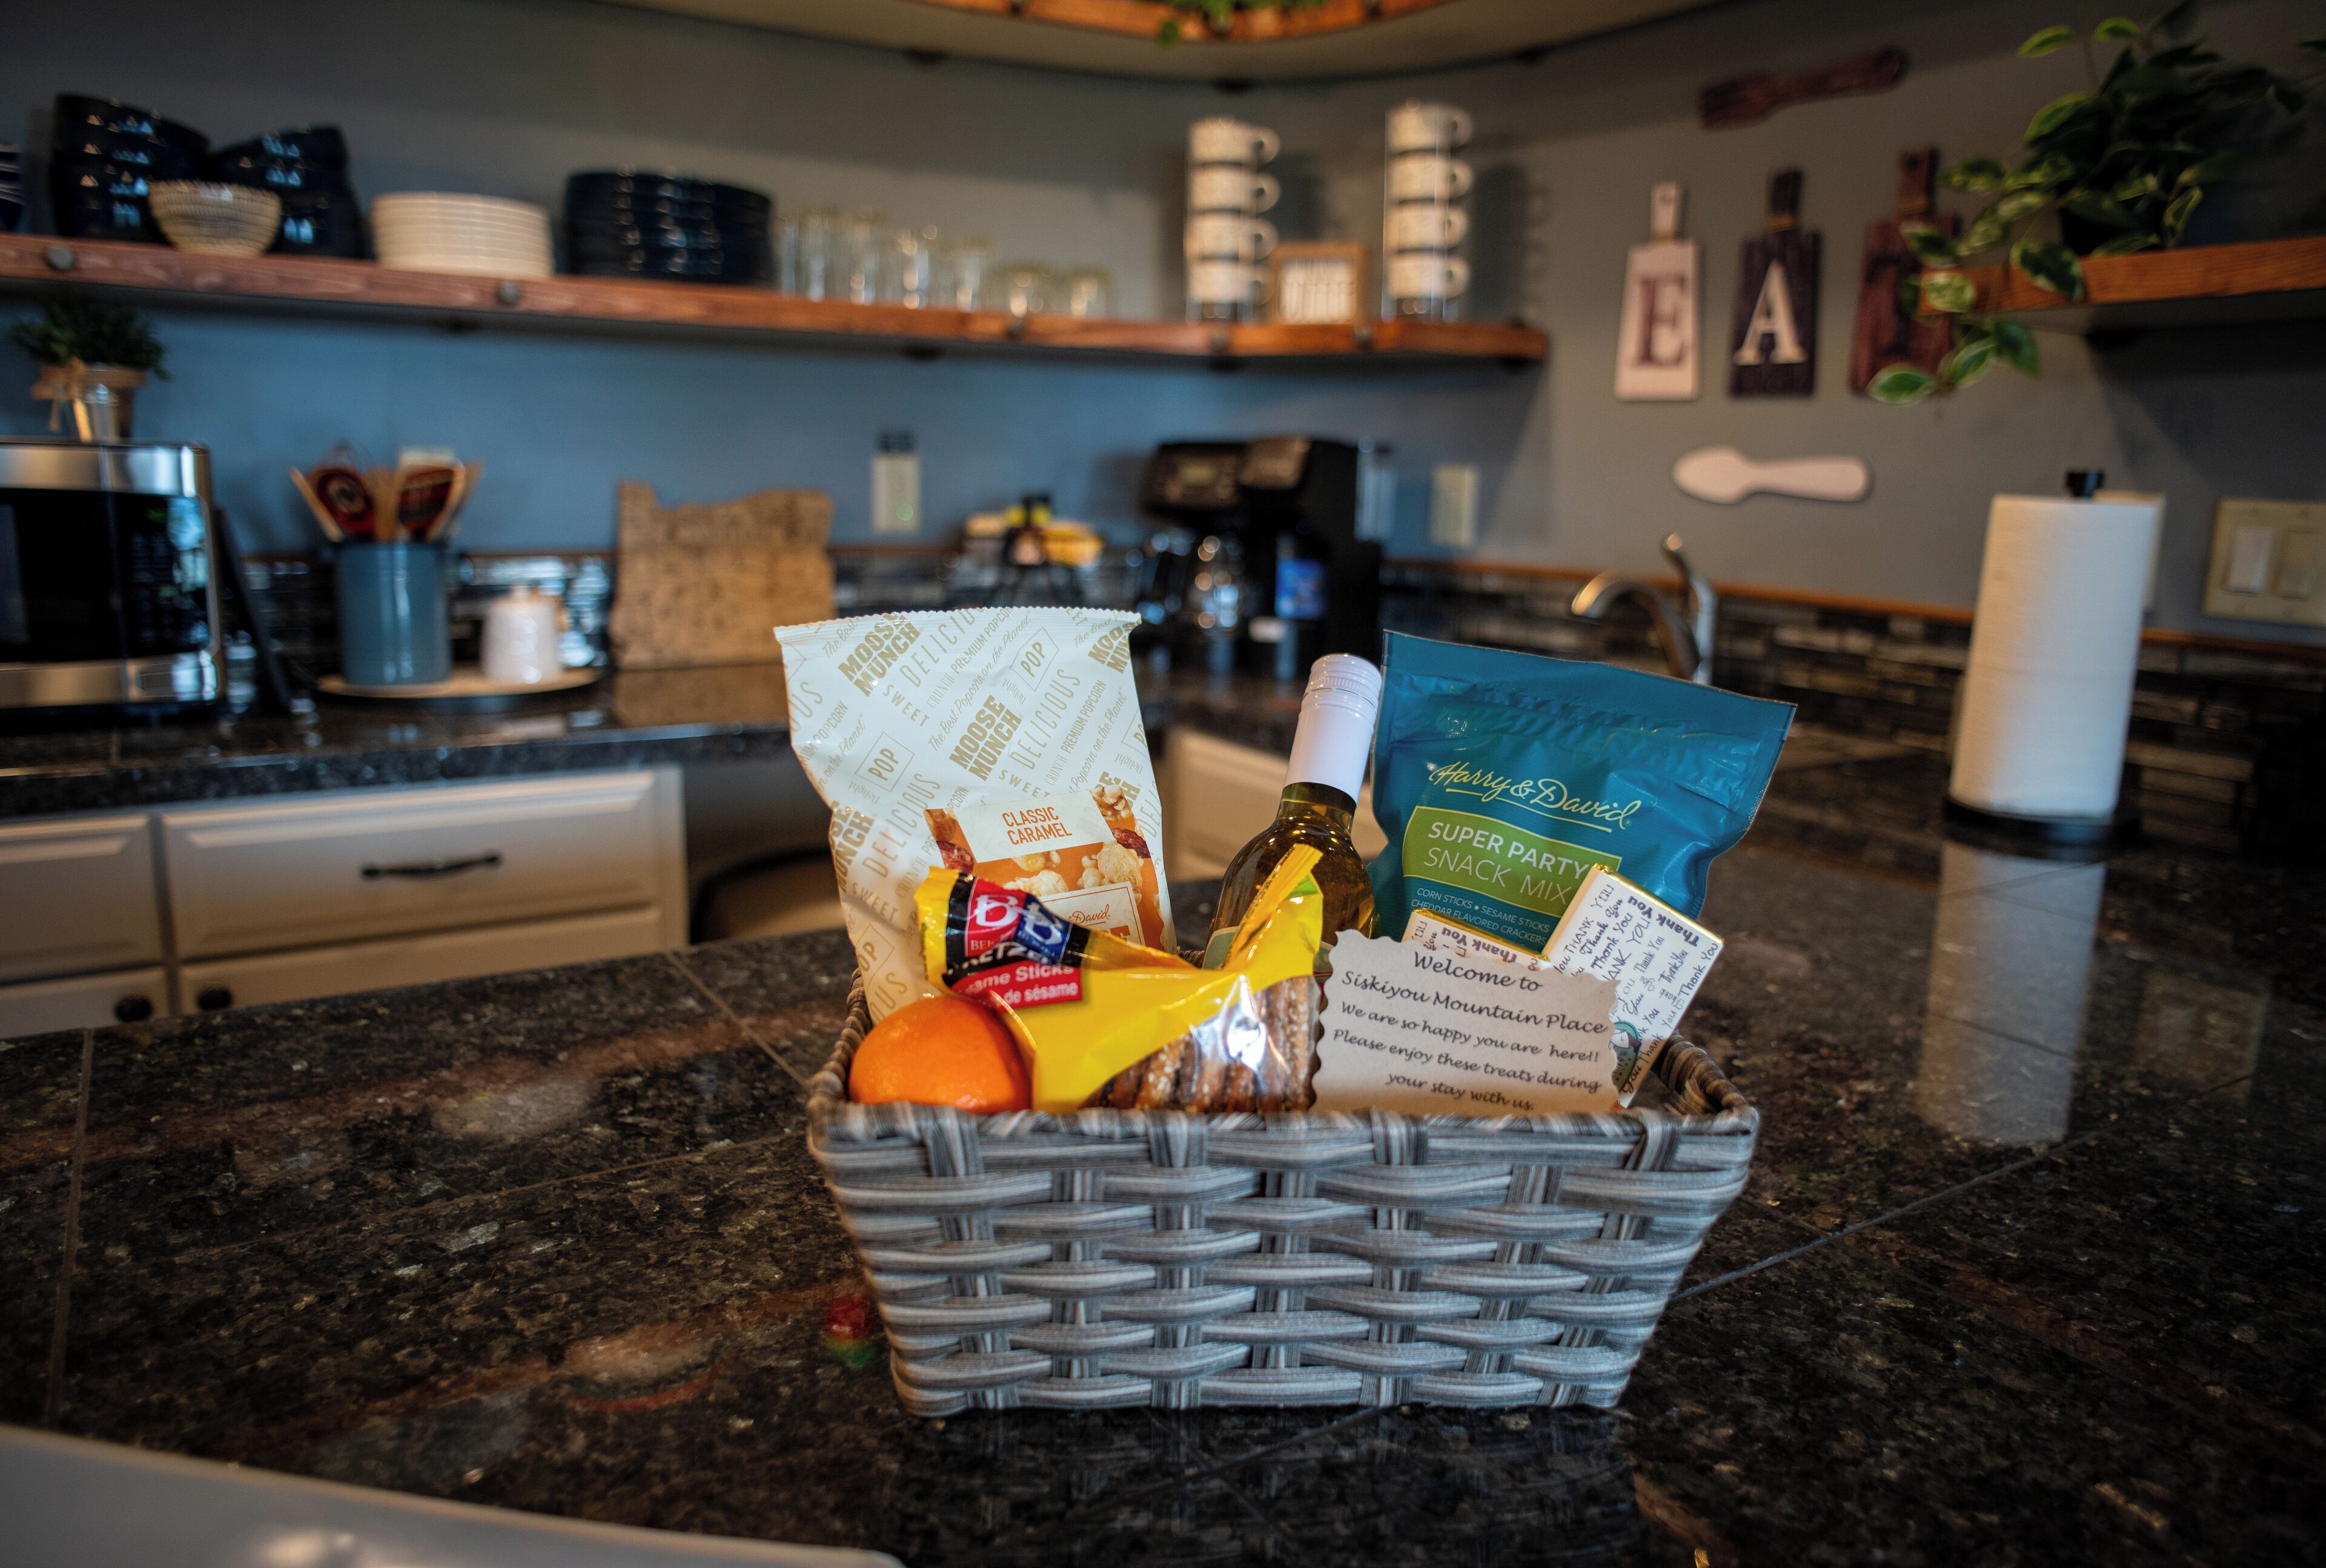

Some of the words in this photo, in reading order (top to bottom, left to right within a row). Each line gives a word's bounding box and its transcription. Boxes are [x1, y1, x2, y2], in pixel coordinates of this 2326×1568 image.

[1734, 257, 1807, 366] A
[853, 621, 921, 697] MUNCH
[926, 673, 955, 709] CRUNCH
[950, 631, 989, 674] PREMIUM
[1020, 641, 1046, 678] POP
[883, 684, 930, 727] SWEET
[927, 732, 946, 752] The
[939, 709, 960, 735] Best
[954, 673, 986, 714] Popcorn
[982, 660, 995, 680] on
[992, 644, 1004, 666] the
[1002, 678, 1027, 706] Delight
[813, 701, 849, 743] POPCORN
[949, 695, 1006, 770] MOOSE
[1009, 669, 1081, 770] DELICIOUS
[1044, 755, 1068, 786] CRUNCH
[1061, 715, 1088, 754] PREMIUM
[1079, 680, 1107, 718] POPCORN
[1096, 723, 1113, 739] the
[867, 747, 900, 781] POP
[968, 708, 1022, 781] MUNCH
[1093, 738, 1105, 752] on
[1115, 753, 1144, 775] Delight
[1070, 751, 1098, 789] Popcorn
[862, 773, 941, 879] DELICIOUS
[1002, 806, 1059, 827] CLASSIC
[1007, 822, 1073, 845] CARAMEL
[1427, 821, 1505, 854] SUPER
[1506, 841, 1590, 880] PARTY
[1424, 847, 1512, 888] SNACK
[1519, 875, 1572, 905] MIX
[852, 882, 898, 921] SWEET
[1411, 899, 1452, 918] CHEDDAR
[1453, 910, 1500, 931] FLAVORED
[1500, 925, 1548, 945] CRACKERS
[1417, 887, 1443, 901] CORN
[1443, 895, 1473, 910] STICKS
[1482, 905, 1517, 924] SESAME
[1518, 917, 1551, 934] STICKS
[1563, 917, 1594, 955] THANK
[1590, 884, 1614, 908] YOU
[1627, 895, 1654, 919] You
[1441, 927, 1467, 946] You
[1579, 922, 1609, 954] Thank
[1605, 898, 1623, 919] You
[1590, 937, 1620, 970] Thank
[1612, 912, 1633, 935] You
[1626, 918, 1651, 945] YOU
[1655, 913, 1700, 947] Thank
[1414, 951, 1516, 987] Welcome
[1519, 976, 1543, 991] to
[1633, 951, 1655, 973] Thank
[1647, 936, 1665, 951] You
[1658, 962, 1678, 984] Thank
[1670, 949, 1689, 965] You
[1678, 965, 1706, 997] Thank
[1700, 943, 1718, 961] You
[1341, 971, 1431, 1002] Siskiyou
[1433, 991, 1543, 1025] Mountain
[1546, 1014, 1609, 1034] Place
[1622, 993, 1644, 1016] You
[1642, 1008, 1660, 1025] You
[1341, 1001, 1367, 1017] We
[1368, 1011, 1399, 1025] are
[1400, 1019, 1419, 1030] so
[1421, 1021, 1471, 1044] happy
[1473, 1034, 1509, 1049] you
[1510, 1041, 1542, 1054] are
[1549, 1044, 1599, 1062] here!!
[1637, 1033, 1664, 1064] Thank
[1660, 1010, 1678, 1030] You
[1333, 1029, 1387, 1051] Please
[1389, 1044, 1433, 1064] enjoy
[1437, 1052, 1482, 1071] these
[1483, 1062, 1535, 1083] treats
[1537, 1071, 1603, 1094] during
[1385, 1073, 1428, 1088] your
[1431, 1082, 1466, 1100] stay
[1471, 1090, 1510, 1106] with
[1513, 1099, 1534, 1111] us.
